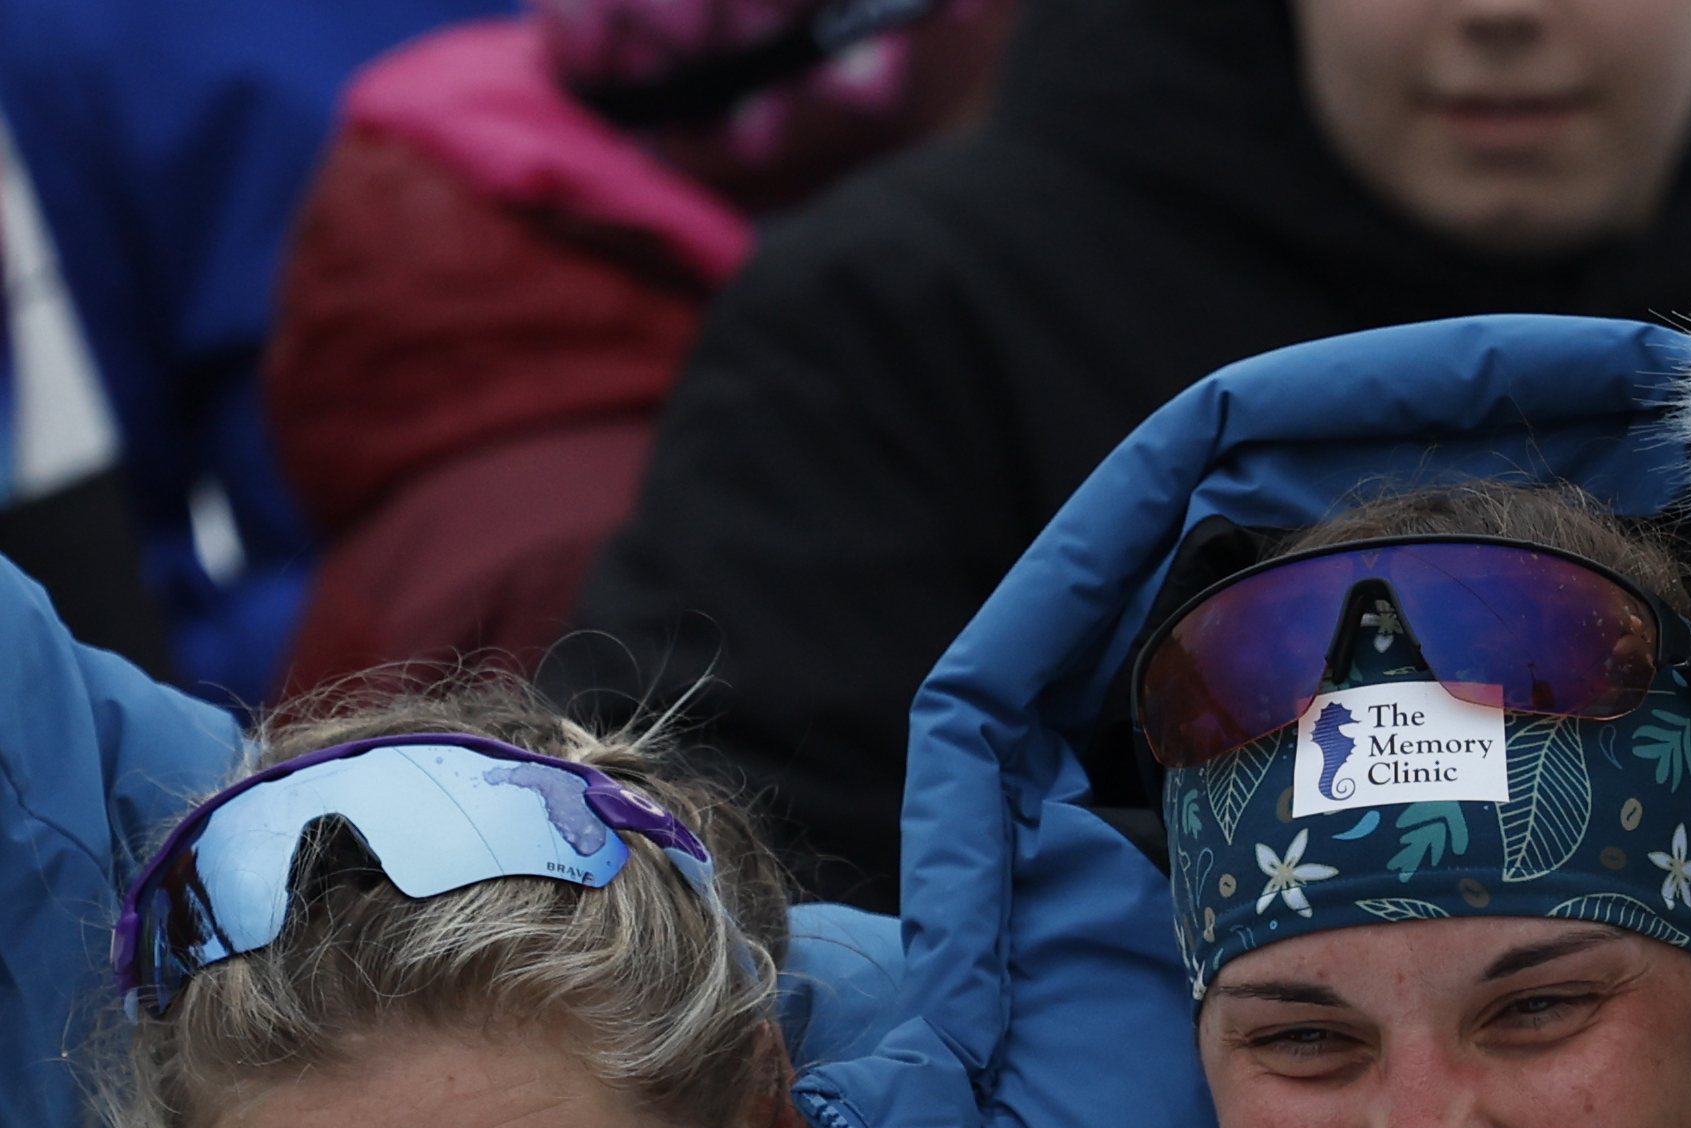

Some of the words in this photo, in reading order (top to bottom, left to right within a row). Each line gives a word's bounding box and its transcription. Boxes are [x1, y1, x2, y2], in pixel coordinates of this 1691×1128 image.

[1367, 703, 1426, 728] The
[1367, 733, 1494, 759] Memory
[1367, 760, 1459, 786] Clinic
